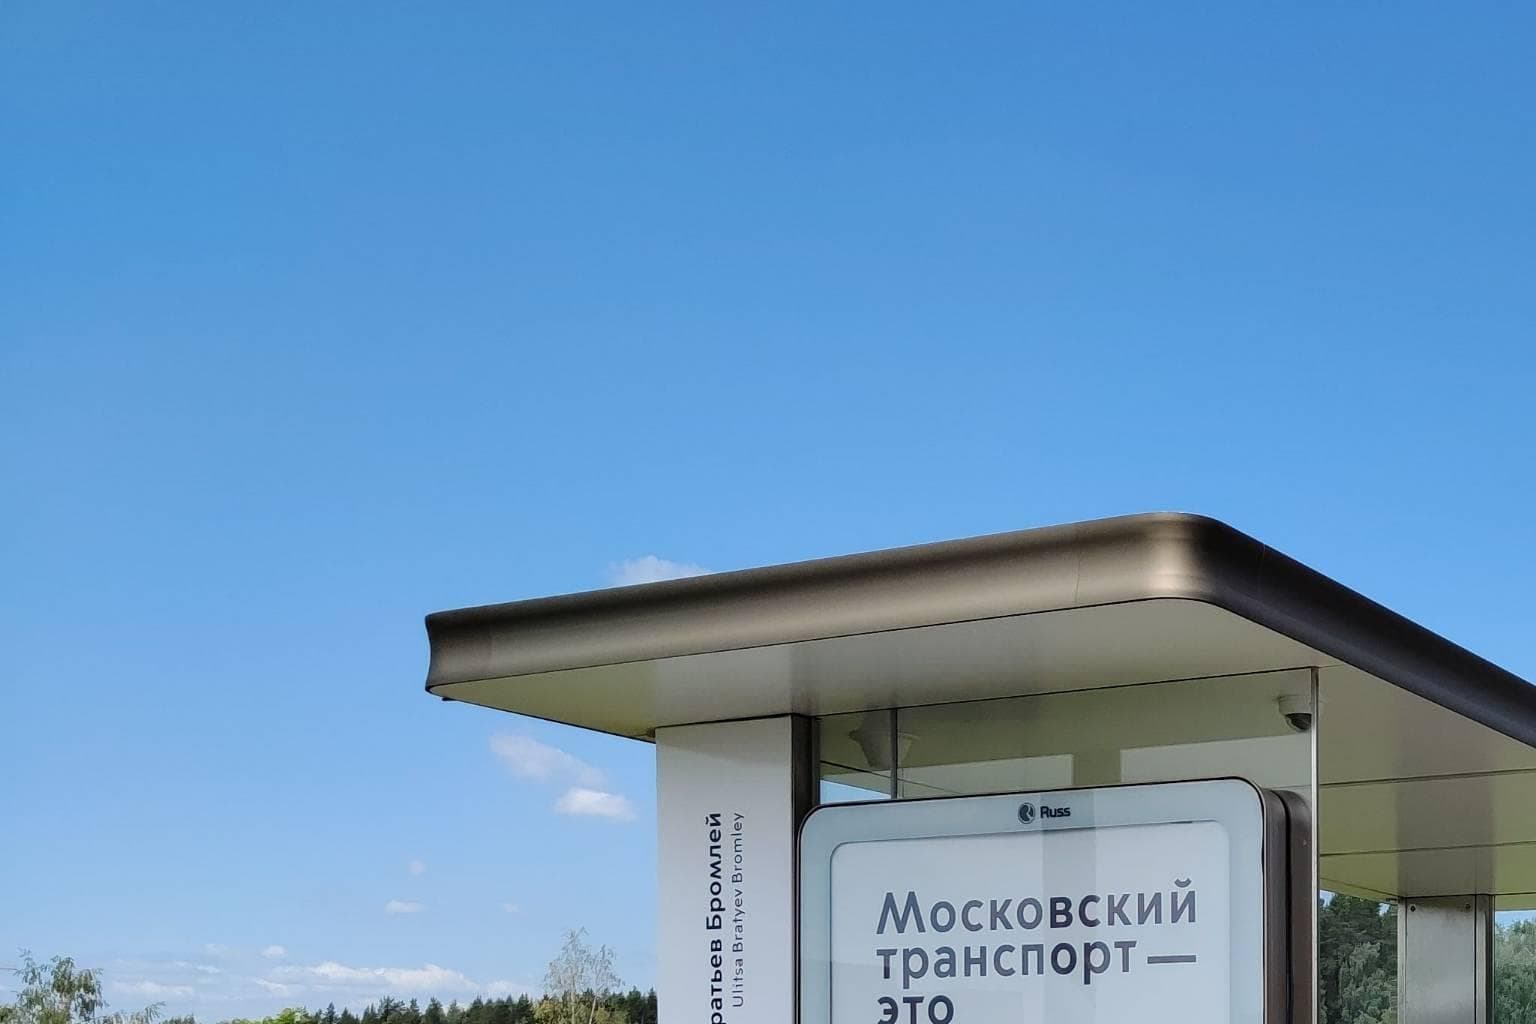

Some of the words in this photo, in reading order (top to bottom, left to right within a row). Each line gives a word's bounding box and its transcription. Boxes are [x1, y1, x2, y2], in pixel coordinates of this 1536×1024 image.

[1040, 805, 1071, 819] Russ
[705, 813, 726, 931] Бромлей
[730, 812, 745, 883] Bromley
[732, 888, 746, 953] Bratyev
[876, 877, 1197, 935] Московский
[731, 958, 744, 1008] Ulitsa
[876, 939, 1138, 990] транспорт
